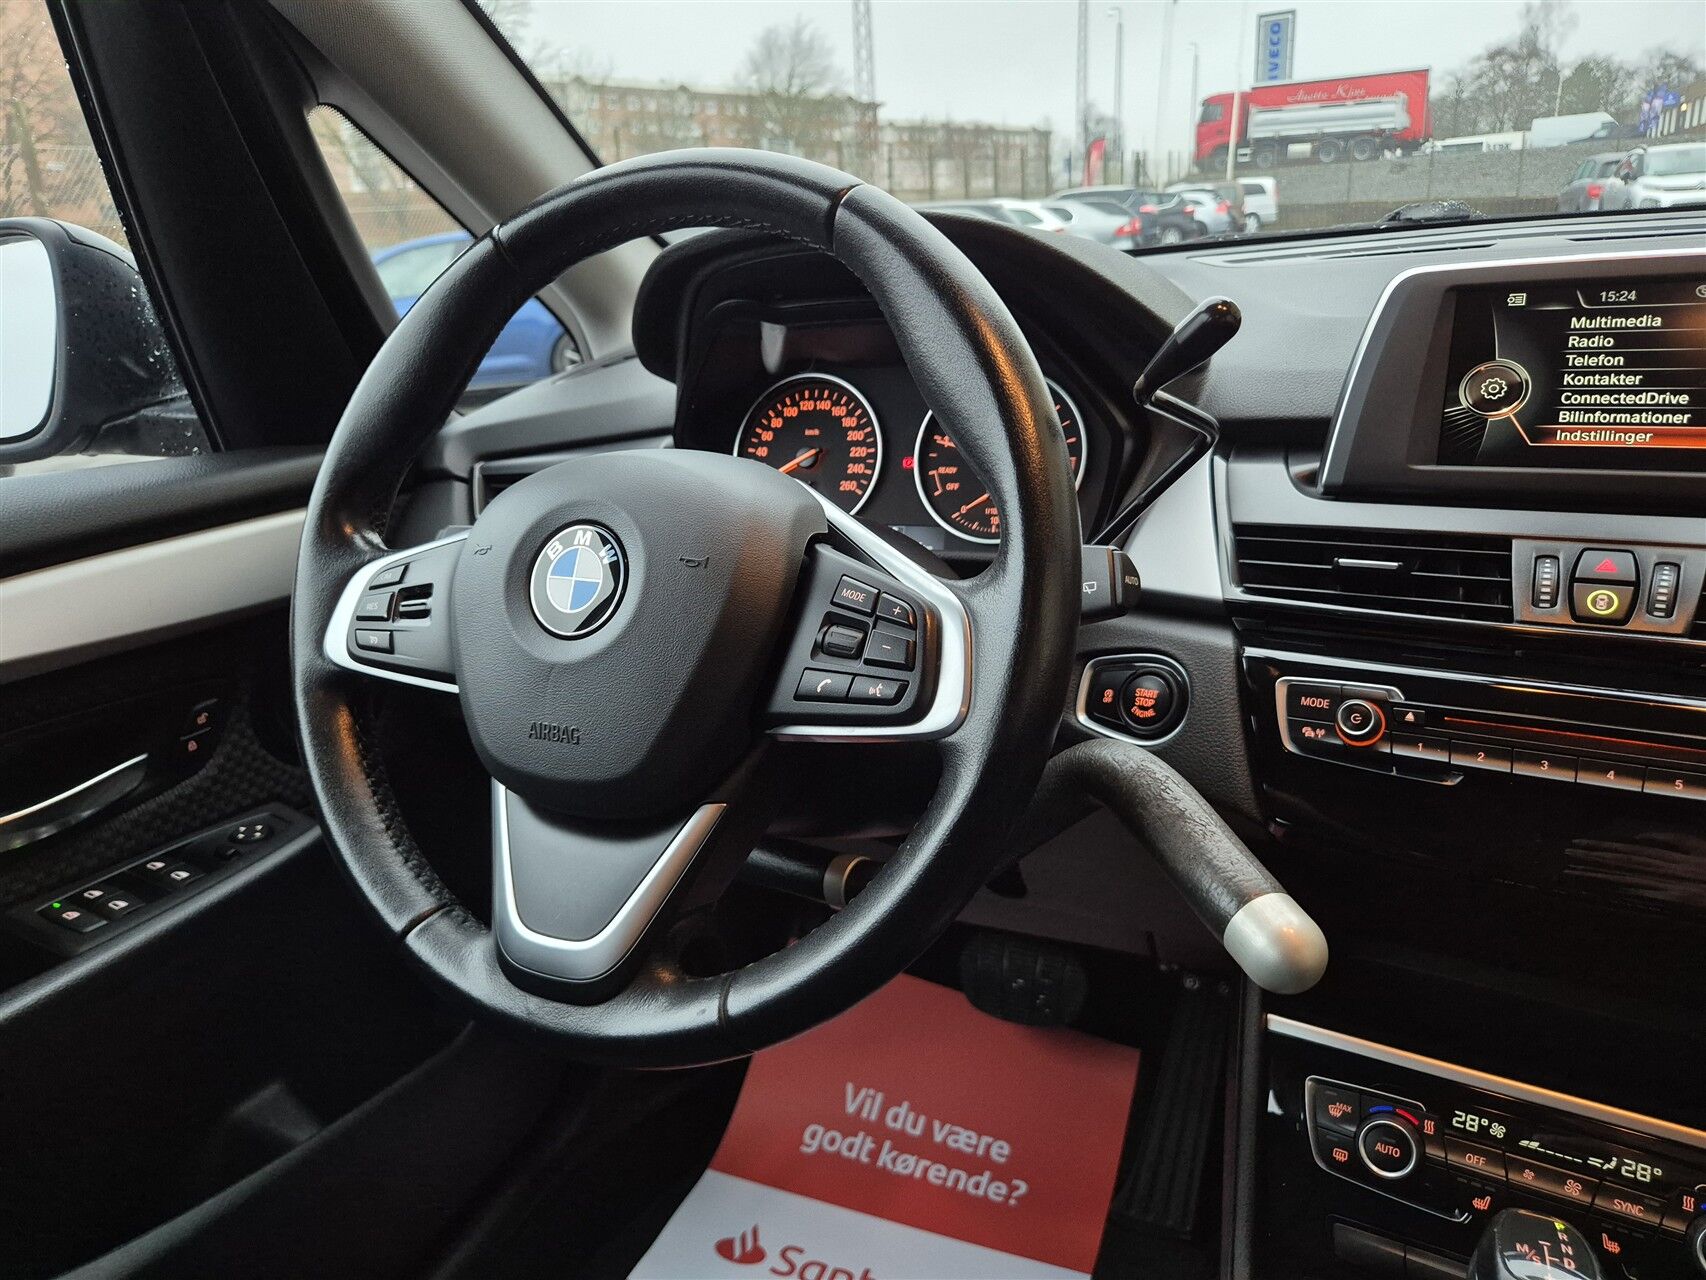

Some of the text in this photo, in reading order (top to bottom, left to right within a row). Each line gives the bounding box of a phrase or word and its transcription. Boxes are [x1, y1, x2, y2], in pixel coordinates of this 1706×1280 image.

[1268, 21, 1281, 80] IVECO
[1600, 290, 1637, 302] 15:24
[1570, 315, 1662, 329] Multimedia
[1568, 335, 1614, 348] Radio
[1565, 354, 1624, 367] Telefon
[1563, 373, 1643, 386] Kontakter
[1560, 391, 1690, 405] ConnectedDrive
[800, 400, 814, 411] 120
[816, 400, 831, 411] 140
[831, 406, 847, 416] 160
[783, 406, 799, 417] 100
[770, 417, 783, 428] 80
[841, 417, 857, 428] 180
[1558, 411, 1692, 424] Bilinformationer
[761, 430, 774, 441] 60
[846, 430, 864, 441] 200
[1555, 429, 1654, 445] Indstillinger
[755, 446, 769, 457] 40
[849, 446, 867, 457] 220
[846, 463, 865, 474] 240
[839, 480, 857, 491] 260
[946, 482, 960, 491] OFF
[546, 529, 618, 566] BMW
[1124, 574, 1140, 586] AUTO
[841, 587, 866, 602] MODE
[1135, 688, 1159, 699] START
[1135, 697, 1155, 708] STOP
[1301, 696, 1330, 710] MODE
[1131, 706, 1156, 718] ENGINE
[528, 721, 581, 745] AIRBAG
[1417, 742, 1424, 752] 1
[1477, 752, 1485, 762] 2
[1540, 761, 1548, 771] 3
[1606, 770, 1615, 780] 4
[1674, 780, 1683, 790] 5
[1336, 1103, 1353, 1114] MAX
[845, 1082, 1012, 1163] Vil du være
[1375, 1142, 1400, 1158] AUTO
[800, 1123, 1028, 1206] godt kørende?
[1465, 1153, 1486, 1167] OFF
[1613, 1198, 1645, 1217] SYNC
[1557, 1231, 1568, 1242] R
[1560, 1243, 1573, 1256] N
[1563, 1256, 1576, 1271] D
